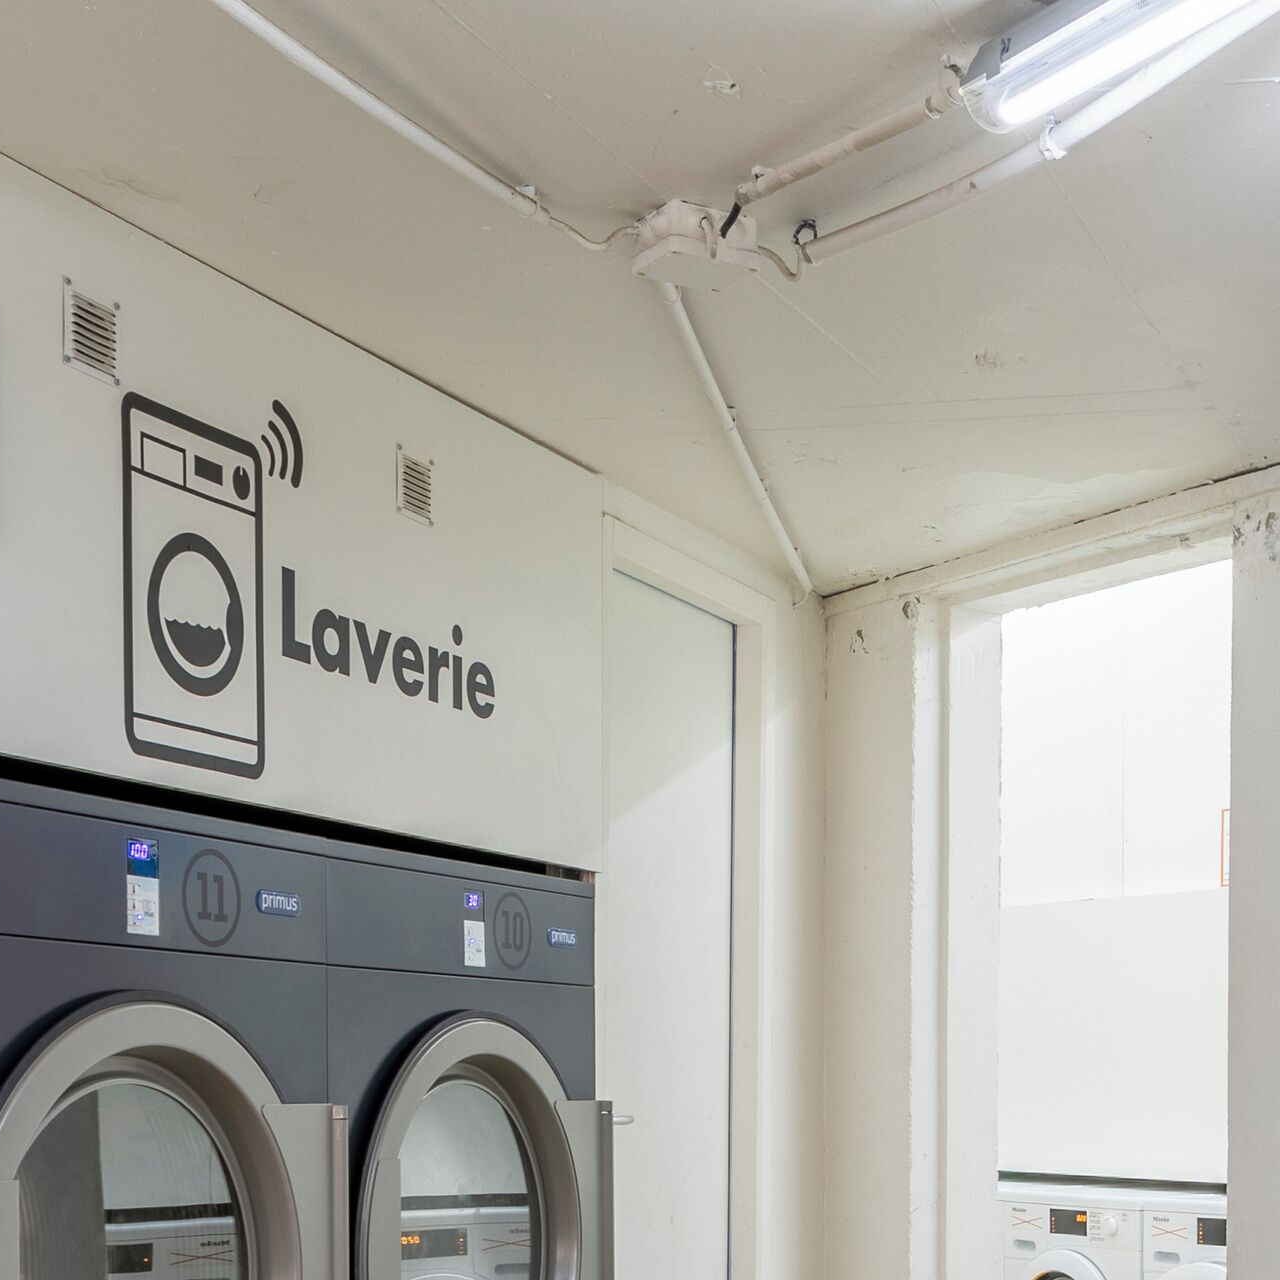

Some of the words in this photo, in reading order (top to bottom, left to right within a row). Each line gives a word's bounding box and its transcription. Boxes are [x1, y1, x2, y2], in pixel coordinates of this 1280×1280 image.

[281, 565, 495, 719] Laverie
[196, 872, 228, 922] 11
[261, 892, 298, 912] primus
[501, 911, 524, 951] 10
[551, 930, 576, 945] primus
